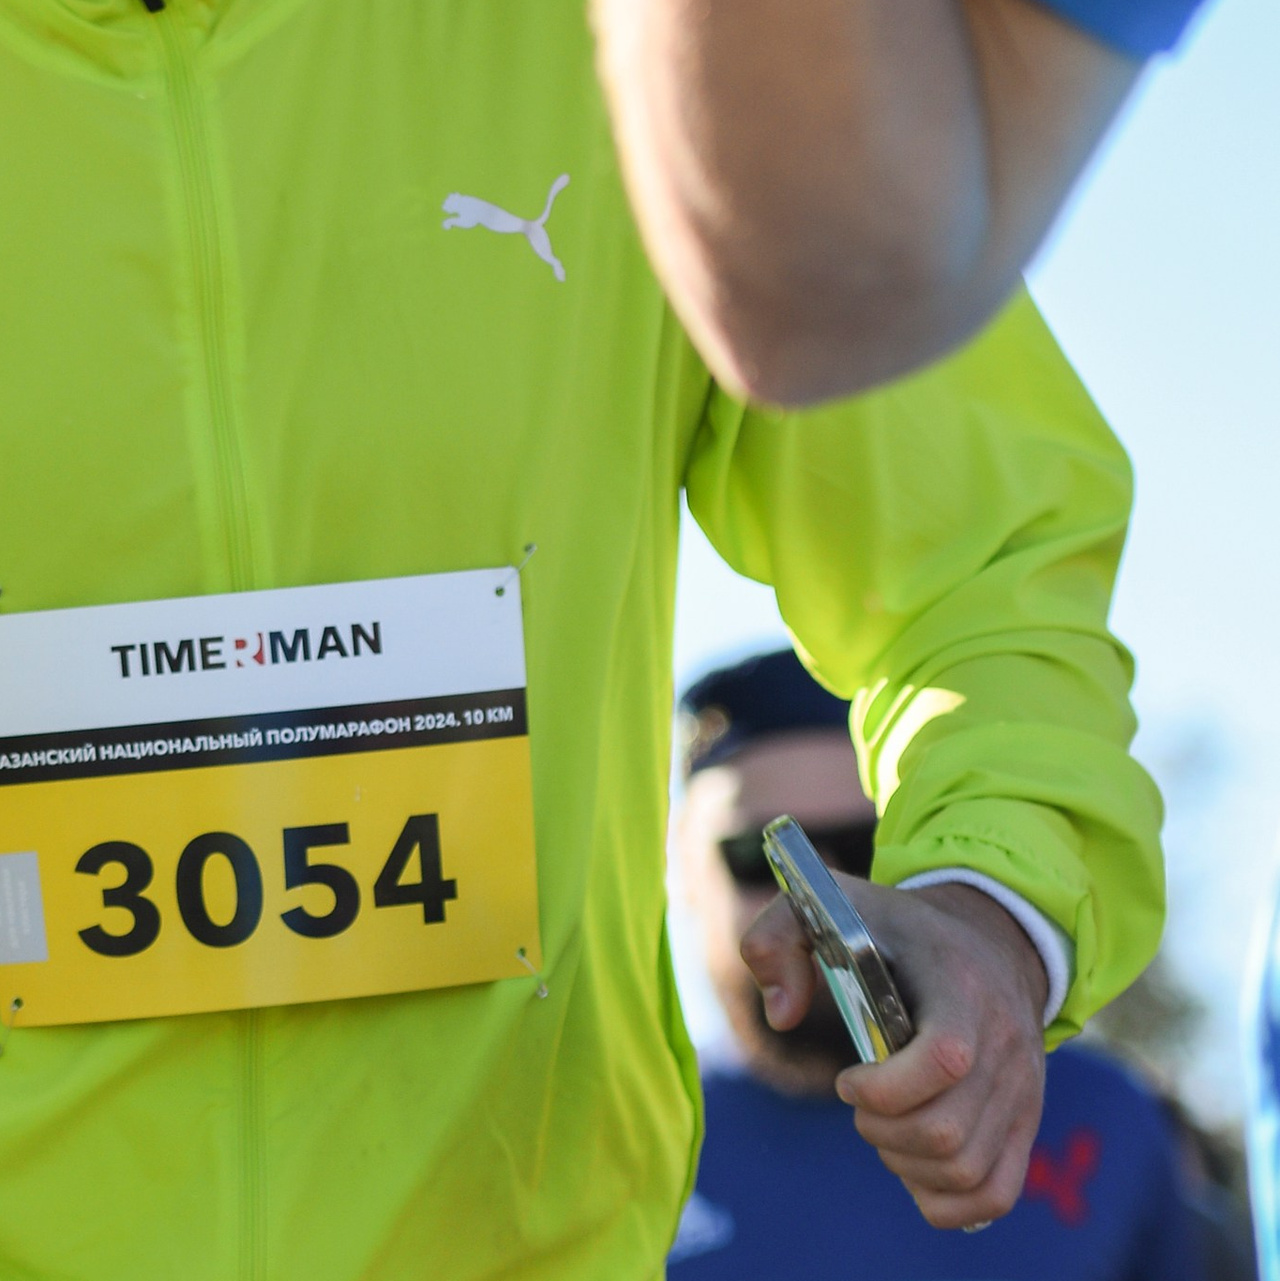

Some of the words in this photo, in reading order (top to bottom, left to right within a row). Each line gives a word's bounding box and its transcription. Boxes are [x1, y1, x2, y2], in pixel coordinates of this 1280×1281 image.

[99, 727, 263, 761] НАЦИОНАЛЬНЫЙ
[266, 715, 411, 745] ПОЛУМАРАФОН
[415, 710, 461, 732] 2024.
[464, 709, 485, 726] 10
[486, 705, 514, 724] КМ
[74, 813, 458, 958] 3054
